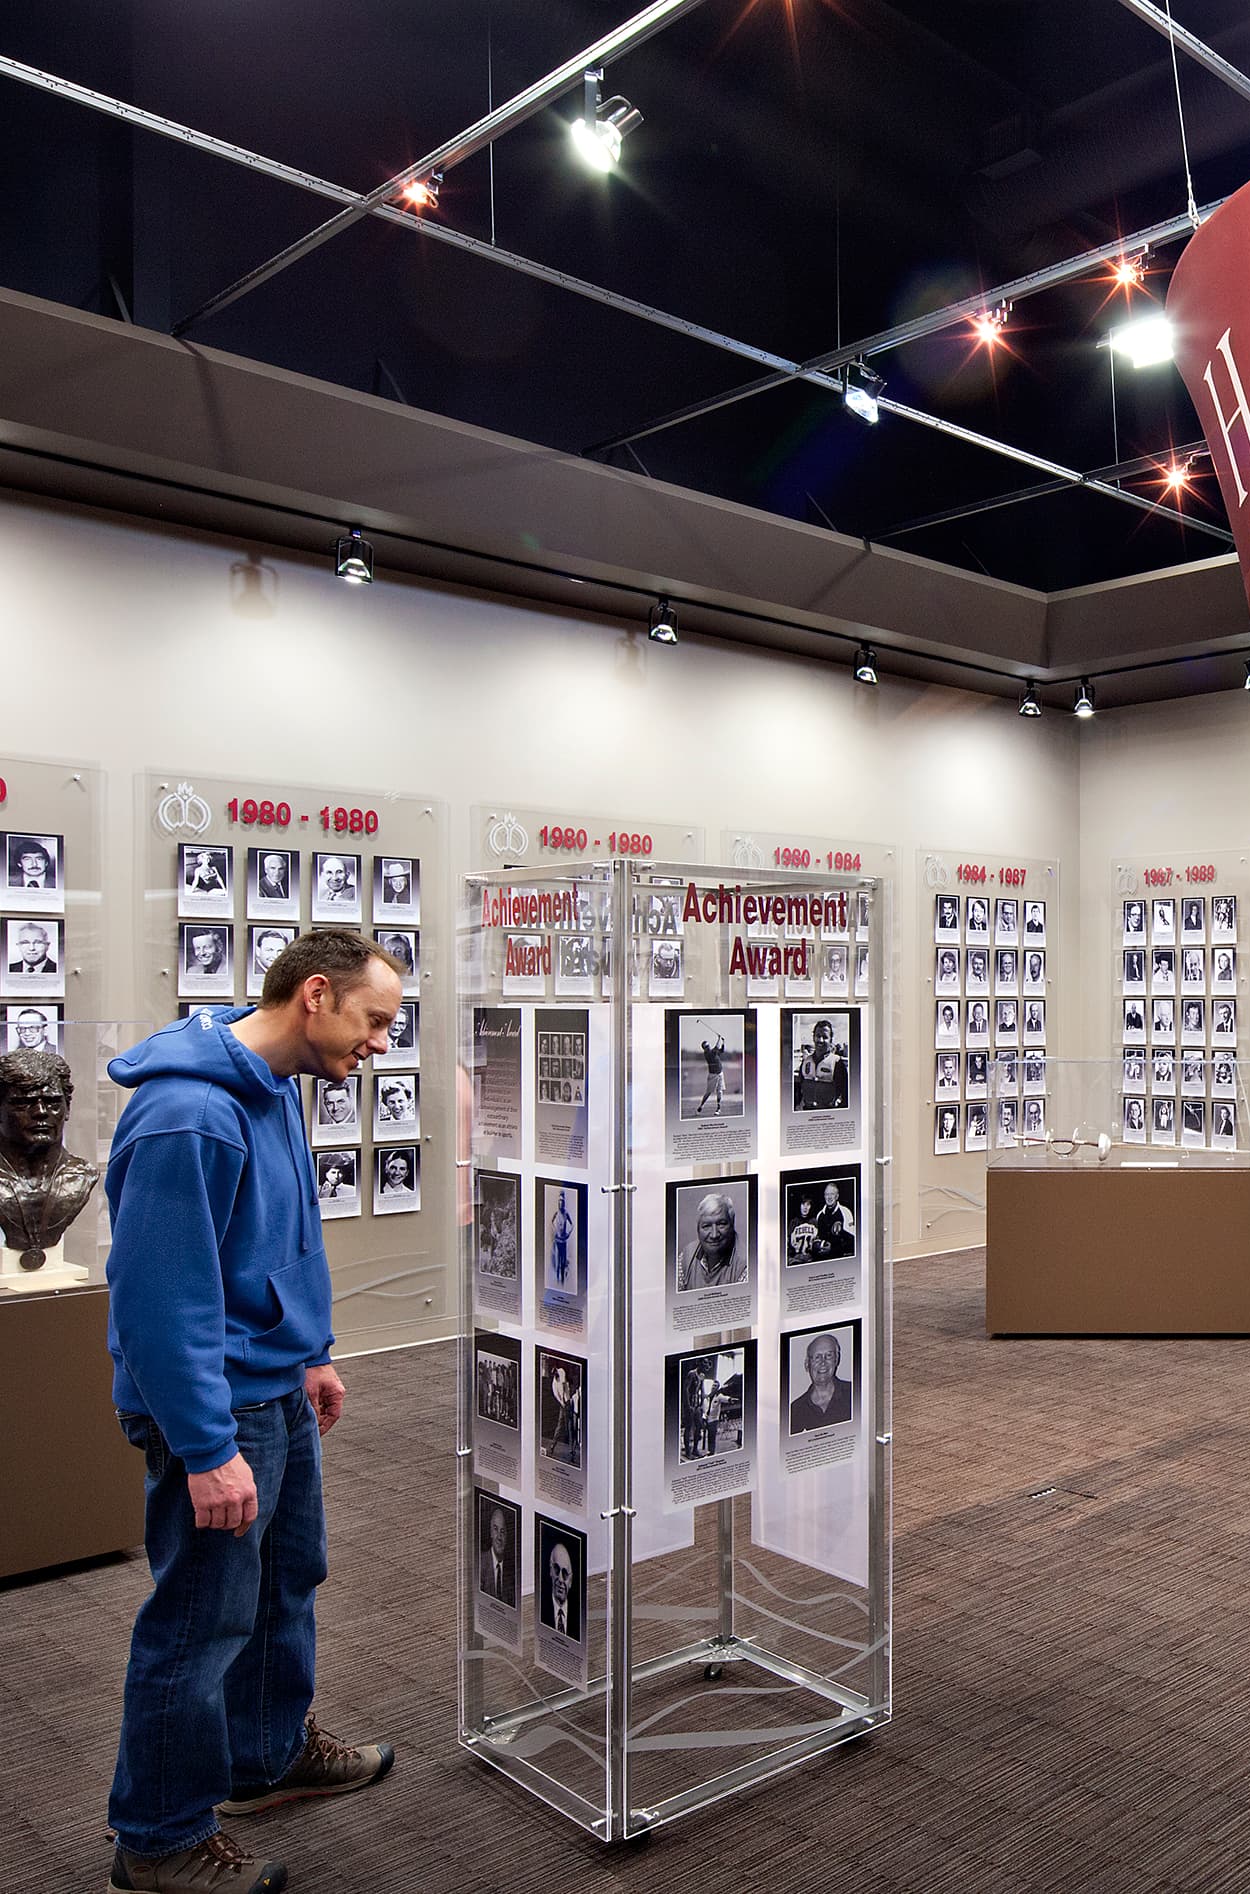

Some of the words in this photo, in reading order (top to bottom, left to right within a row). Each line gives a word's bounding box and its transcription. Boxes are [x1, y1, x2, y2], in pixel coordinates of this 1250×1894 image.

[228, 797, 291, 826] 1980
[320, 806, 378, 833] 1980
[540, 825, 587, 849] 1980
[608, 832, 652, 854] 1980
[775, 847, 810, 869] 1980
[827, 851, 862, 872] 1984
[957, 863, 987, 884] 1984
[999, 867, 1027, 887] 1987
[1143, 867, 1173, 885] 1987
[1185, 860, 1215, 882] 1989
[481, 883, 580, 928] Achievement
[683, 883, 847, 928] Achievement
[505, 935, 552, 977] Award
[729, 936, 808, 976] Award
